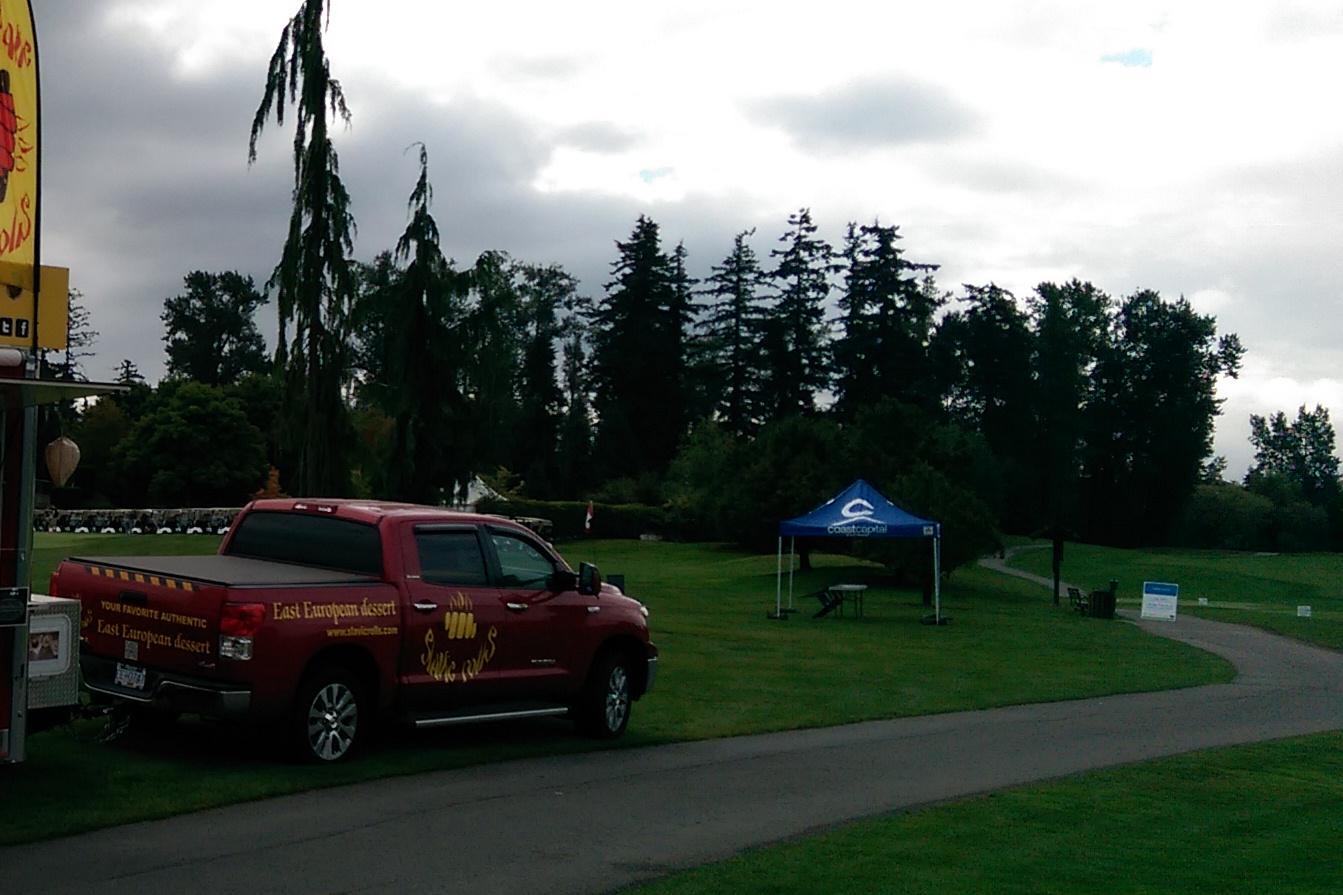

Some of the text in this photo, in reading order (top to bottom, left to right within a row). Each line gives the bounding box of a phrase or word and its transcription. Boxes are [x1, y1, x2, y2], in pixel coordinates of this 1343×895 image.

[101, 600, 207, 629] YOUR FAVORITE AUTHENTIC
[273, 597, 397, 624] East European dessert
[97, 618, 211, 654] East European dessert
